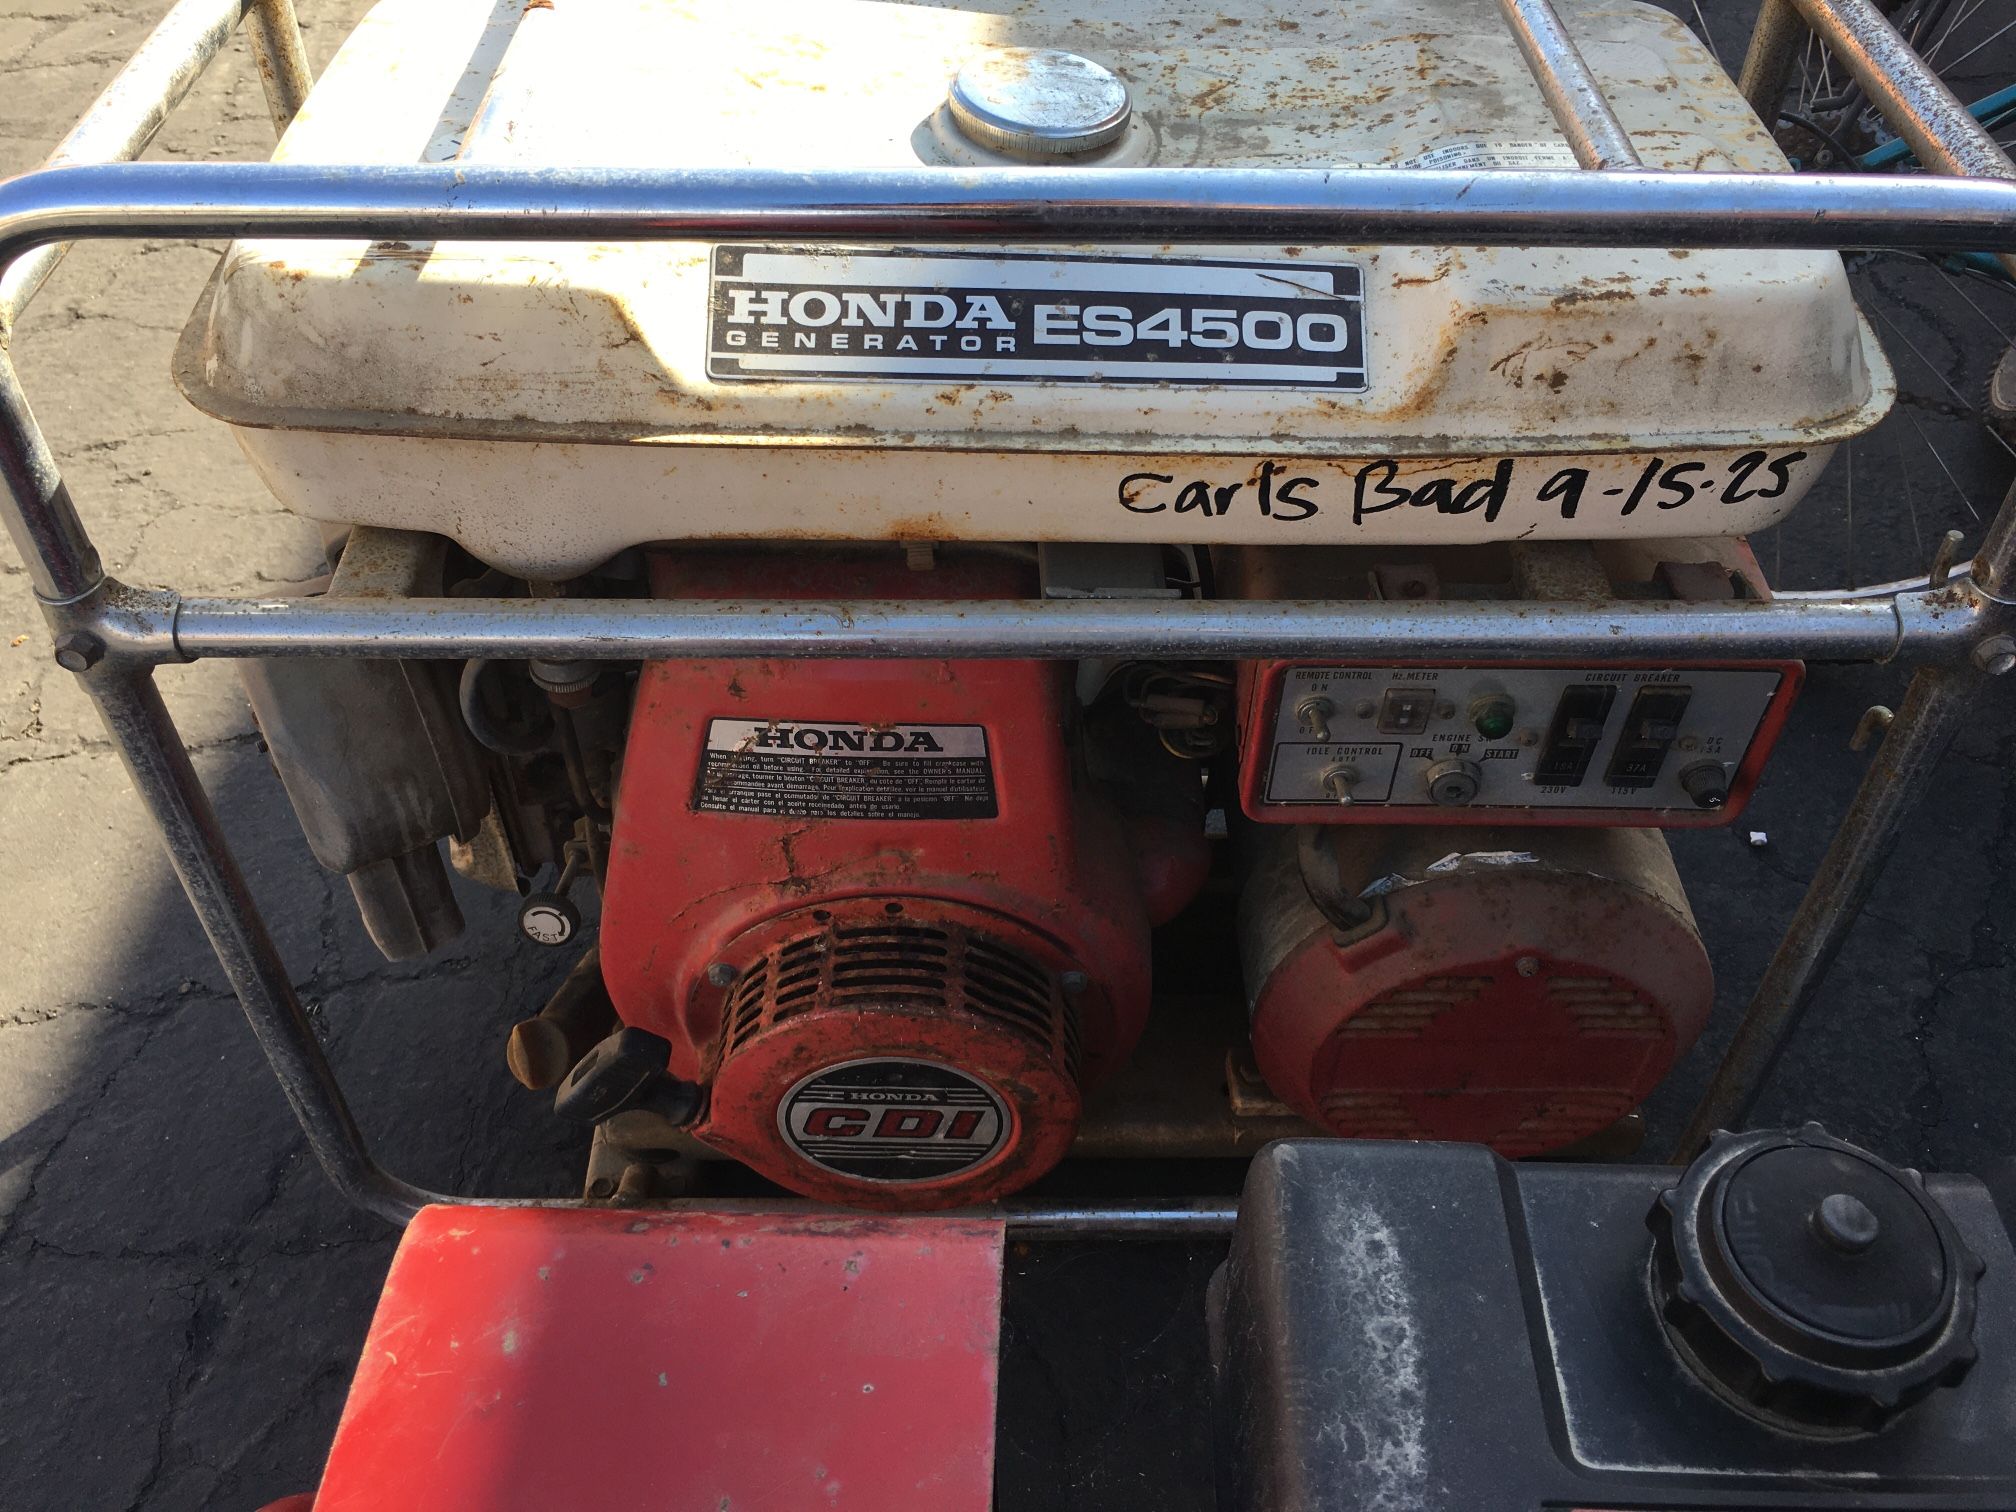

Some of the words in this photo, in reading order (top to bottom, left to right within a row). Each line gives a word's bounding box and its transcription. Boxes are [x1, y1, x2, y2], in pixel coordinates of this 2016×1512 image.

[1442, 145, 1468, 154] INDOORS
[727, 290, 1016, 331] HONDA
[1033, 305, 1349, 352] ES4500
[726, 329, 1016, 353] GENERATOR
[1354, 458, 1513, 526] Bad
[1296, 671, 1330, 680] REMOTE
[1333, 672, 1372, 680] CONTROL
[1585, 673, 1628, 682] CIRCUIT
[1633, 674, 1681, 682] BREAKER
[1312, 683, 1328, 692] ON
[753, 727, 943, 752] HONDA
[1432, 734, 1471, 742] ENGINE
[1706, 736, 1723, 744] DC
[1306, 747, 1329, 755] IDLE
[1337, 747, 1383, 755] CONTROL
[1450, 744, 1469, 753] ON
[709, 752, 726, 760] When
[1411, 749, 1432, 758] OFF
[1486, 750, 1518, 759] START
[1540, 786, 1567, 794] 230V
[700, 802, 727, 810] Consulte
[527, 926, 558, 942] FAST
[850, 1091, 940, 1102] HONDA
[803, 1107, 986, 1140] CDI
